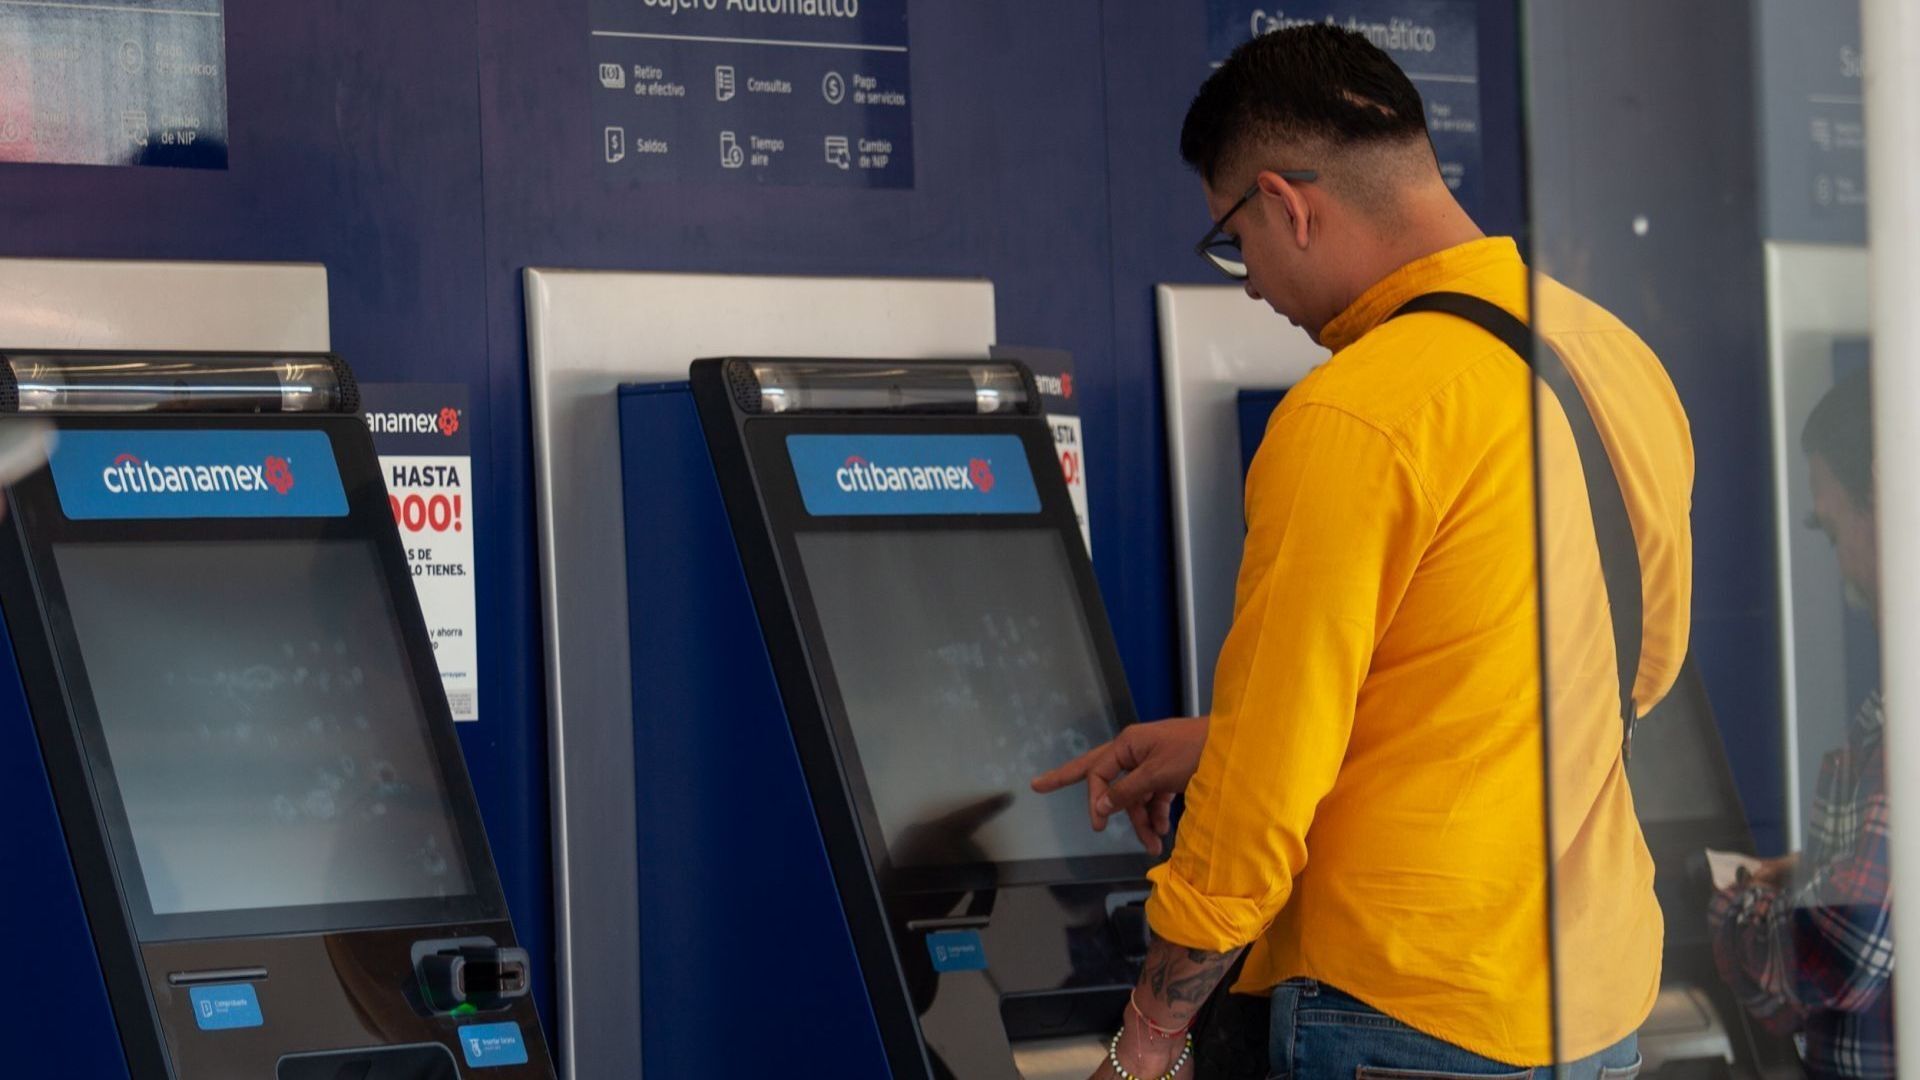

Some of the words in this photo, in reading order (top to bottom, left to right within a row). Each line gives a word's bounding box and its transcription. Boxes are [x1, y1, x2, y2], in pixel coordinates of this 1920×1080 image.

[634, 64, 662, 80] Retiro
[634, 82, 647, 96] de
[648, 81, 685, 97] efectivo
[747, 77, 792, 93] Consultas
[853, 74, 877, 90] Pago
[853, 91, 866, 105] de
[867, 91, 906, 107] servicios
[161, 131, 175, 145] de
[177, 131, 196, 145] NIP
[637, 138, 668, 154] Saldos
[750, 135, 785, 152] Tiempo
[858, 138, 892, 154] Cambio
[751, 152, 769, 166] aire
[859, 154, 871, 168] de
[872, 154, 889, 168] NIP
[103, 454, 269, 494] citibanamex
[392, 465, 461, 488] HASTA
[836, 456, 974, 492] citibanamex
[418, 548, 432, 561] DE
[425, 563, 466, 577] TIENES.
[430, 629, 435, 640] y
[437, 627, 463, 638] ahorra
